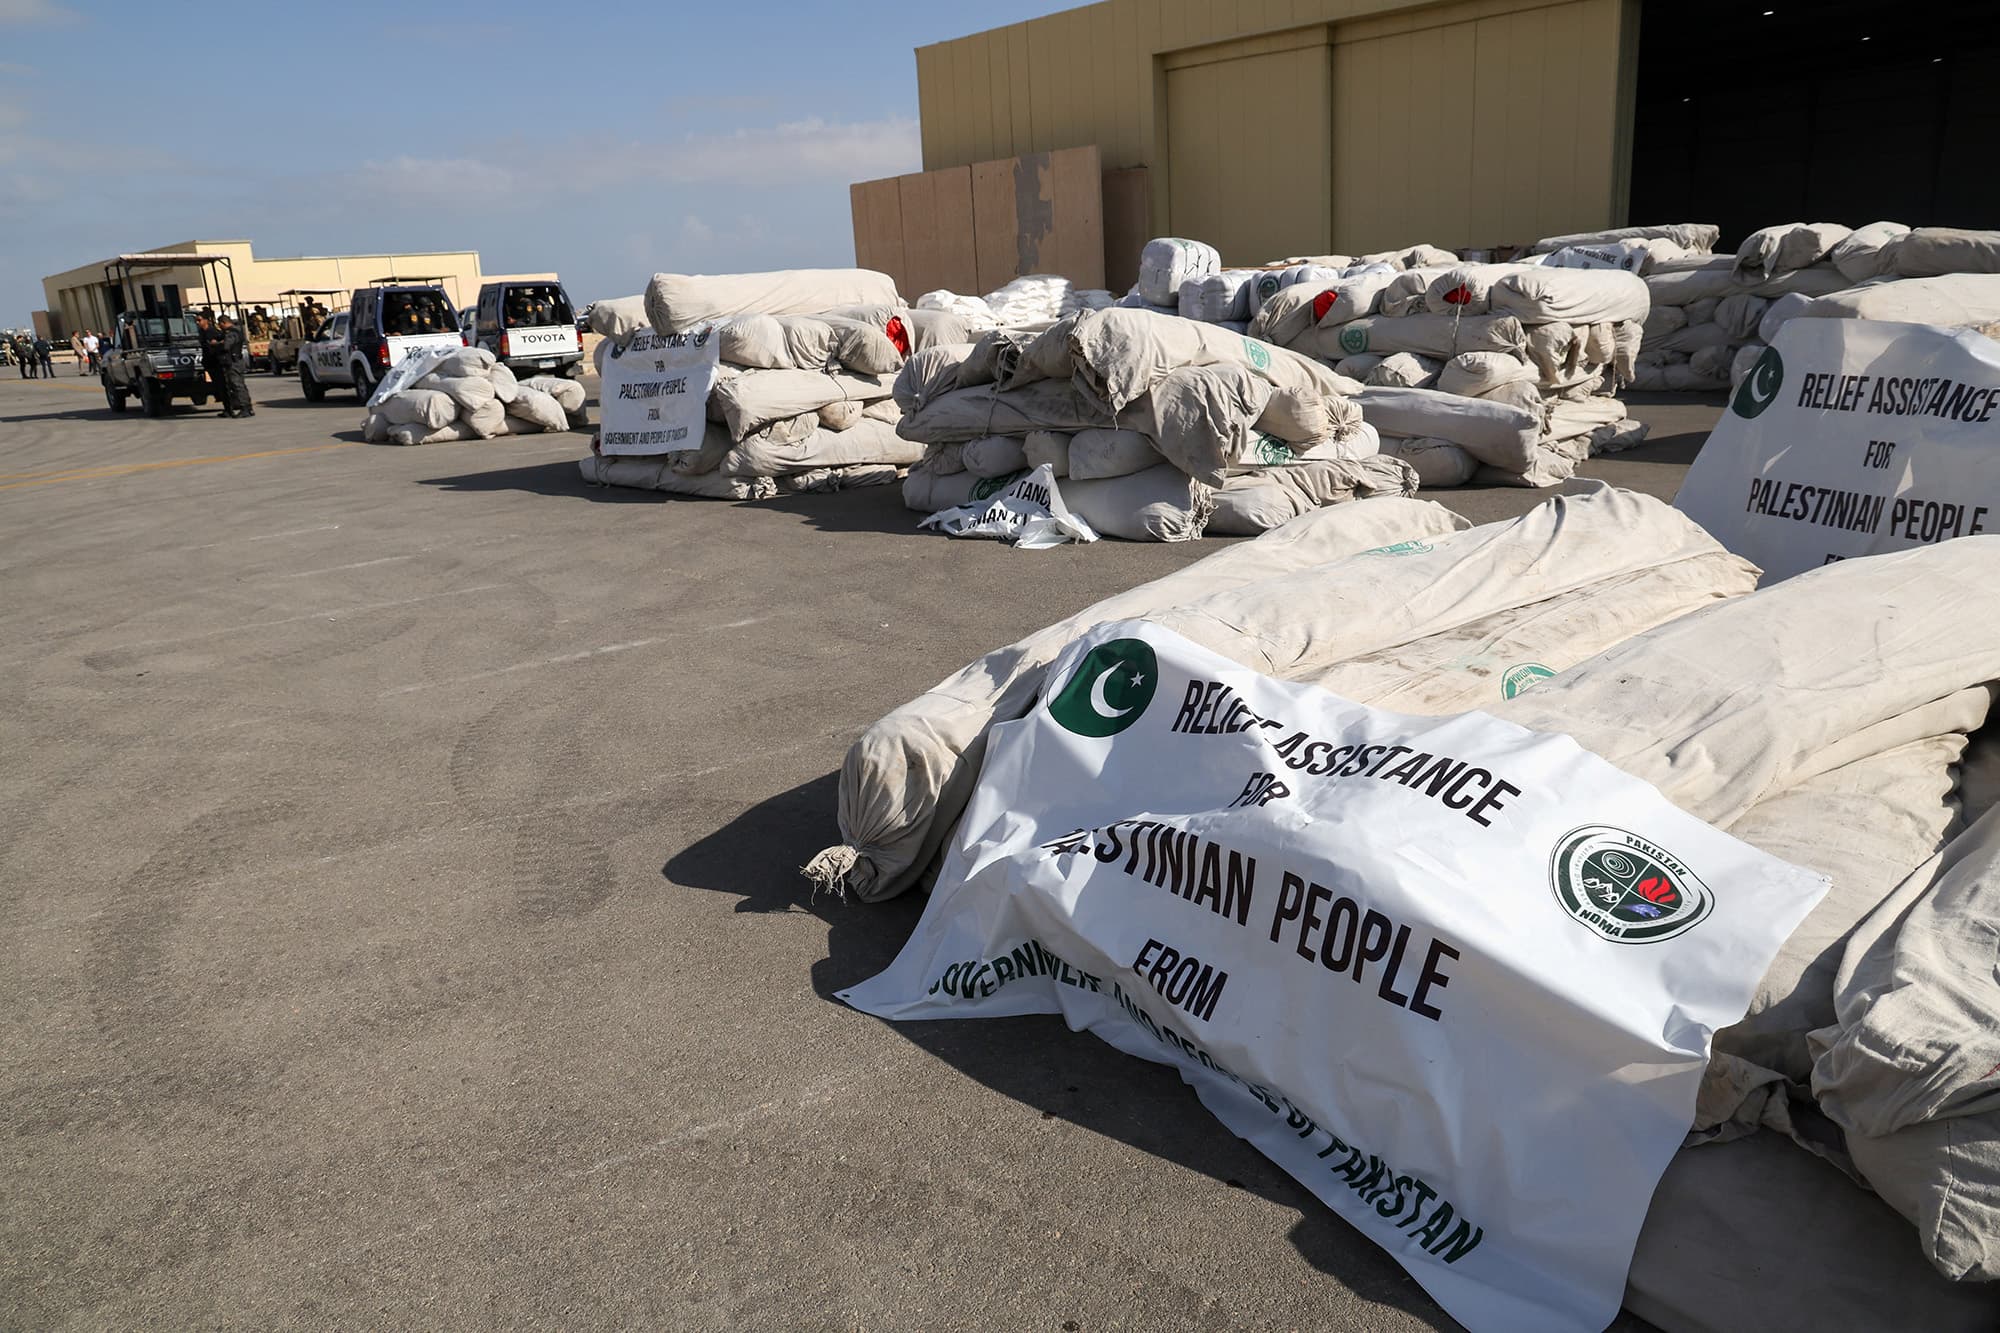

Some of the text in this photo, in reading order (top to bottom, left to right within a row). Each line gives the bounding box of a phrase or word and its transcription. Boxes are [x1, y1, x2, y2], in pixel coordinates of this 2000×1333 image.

[521, 334, 566, 343] TOYOTA
[171, 356, 203, 365] TOY
[317, 351, 343, 367] POLICE
[661, 377, 687, 396] PEOPLE
[1798, 373, 2000, 422] RELIEF ASSISTANCE
[1863, 441, 1896, 469] FOR
[1747, 478, 1886, 534] PALESTINIAN
[1228, 772, 1291, 808] FOR
[1270, 731, 1522, 828] ASSISTANCE
[1626, 835, 1687, 876] PAKISTAN
[1579, 909, 1622, 936] NDMA
[1270, 870, 1461, 1021] PEOPLE
[1132, 938, 1228, 1022] FROM
[1317, 1135, 1483, 1264] PAKISTAN
